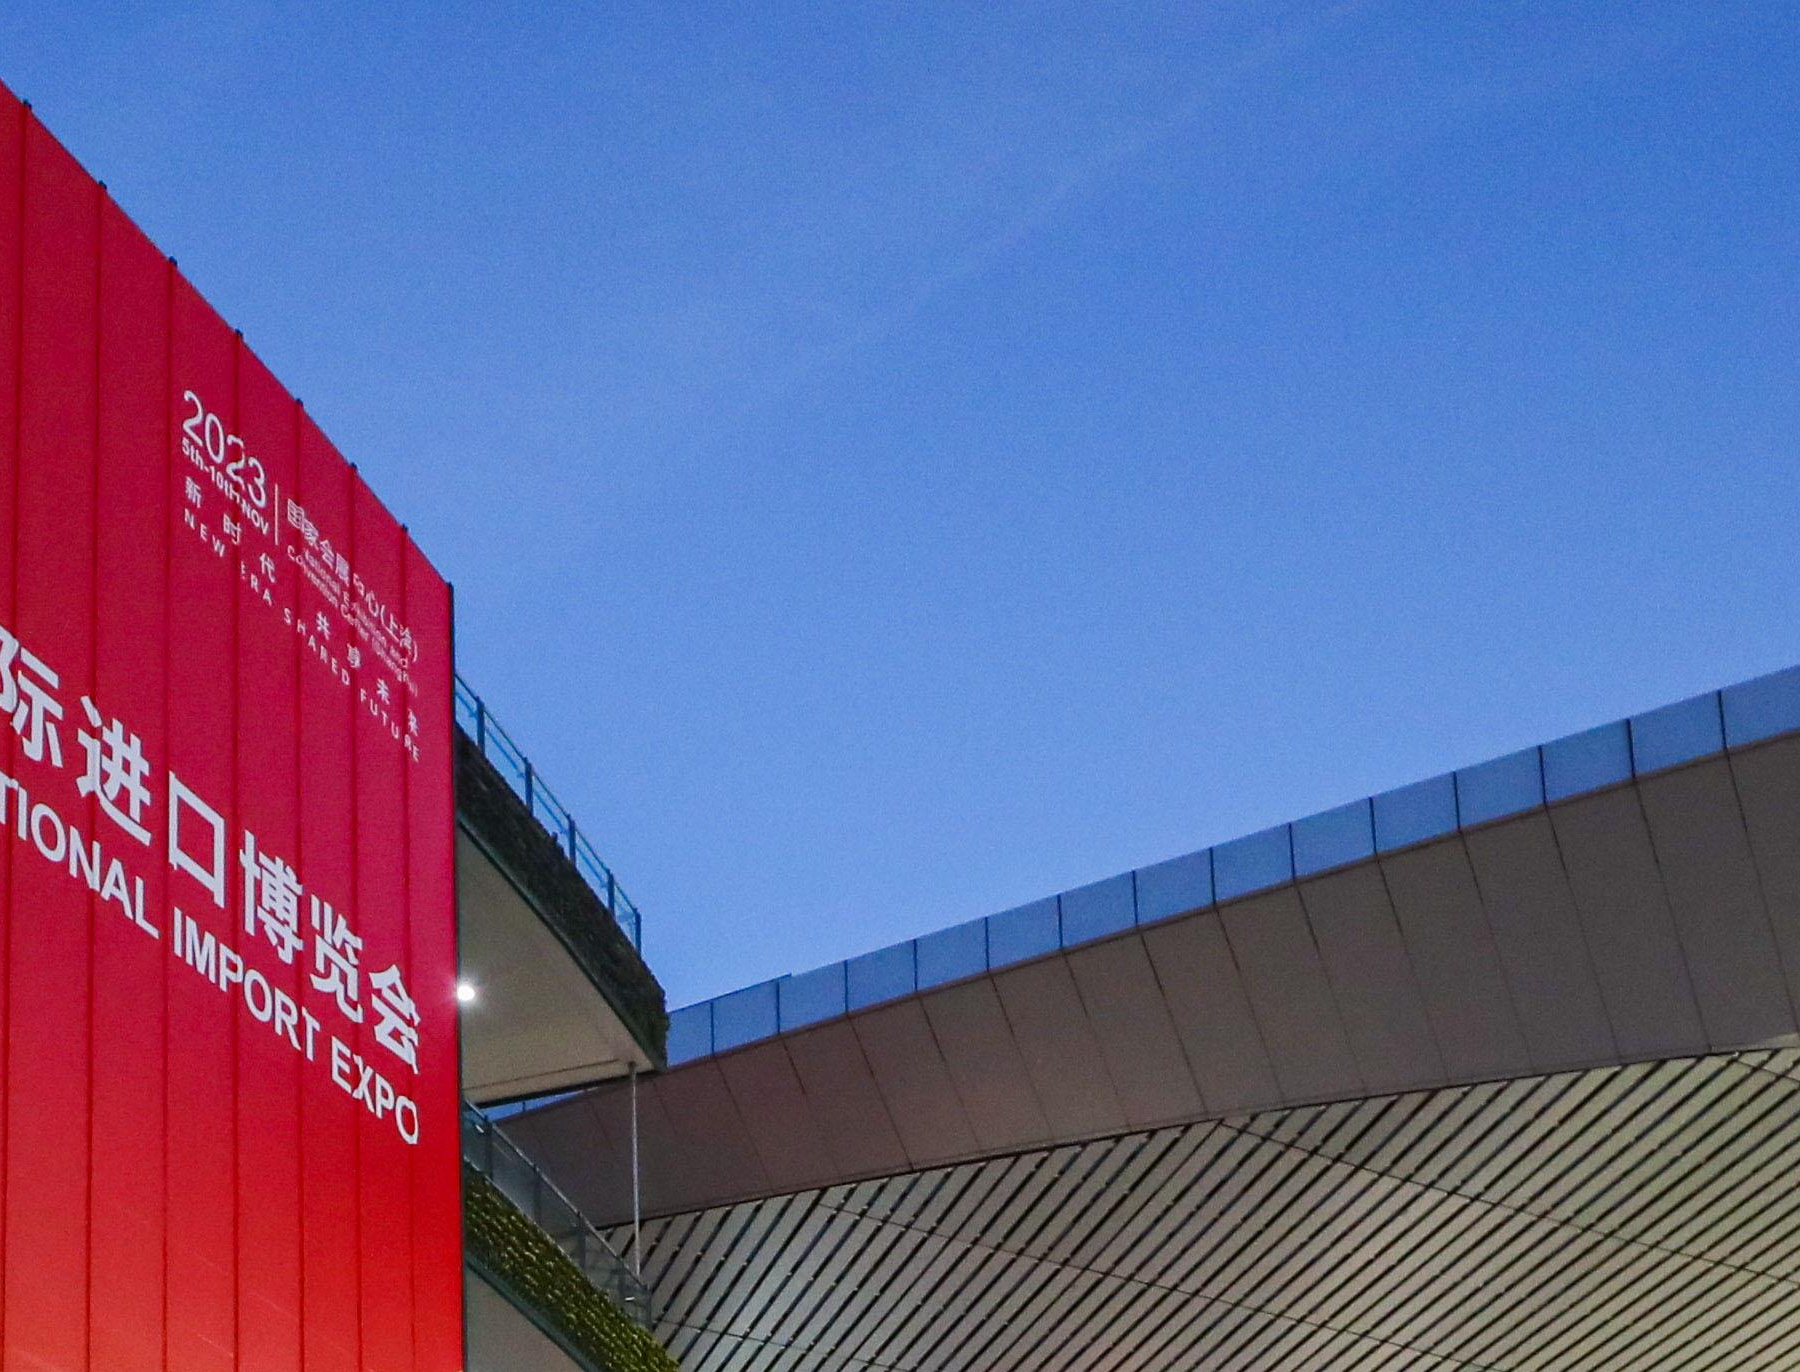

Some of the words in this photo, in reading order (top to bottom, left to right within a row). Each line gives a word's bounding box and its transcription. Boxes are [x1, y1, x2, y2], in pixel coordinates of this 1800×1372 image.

[182, 389, 267, 508] 2023
[185, 508, 226, 558] NEW
[283, 607, 351, 687] SHARED
[173, 907, 321, 1063] IMPORT
[331, 1041, 420, 1146] EXPO
